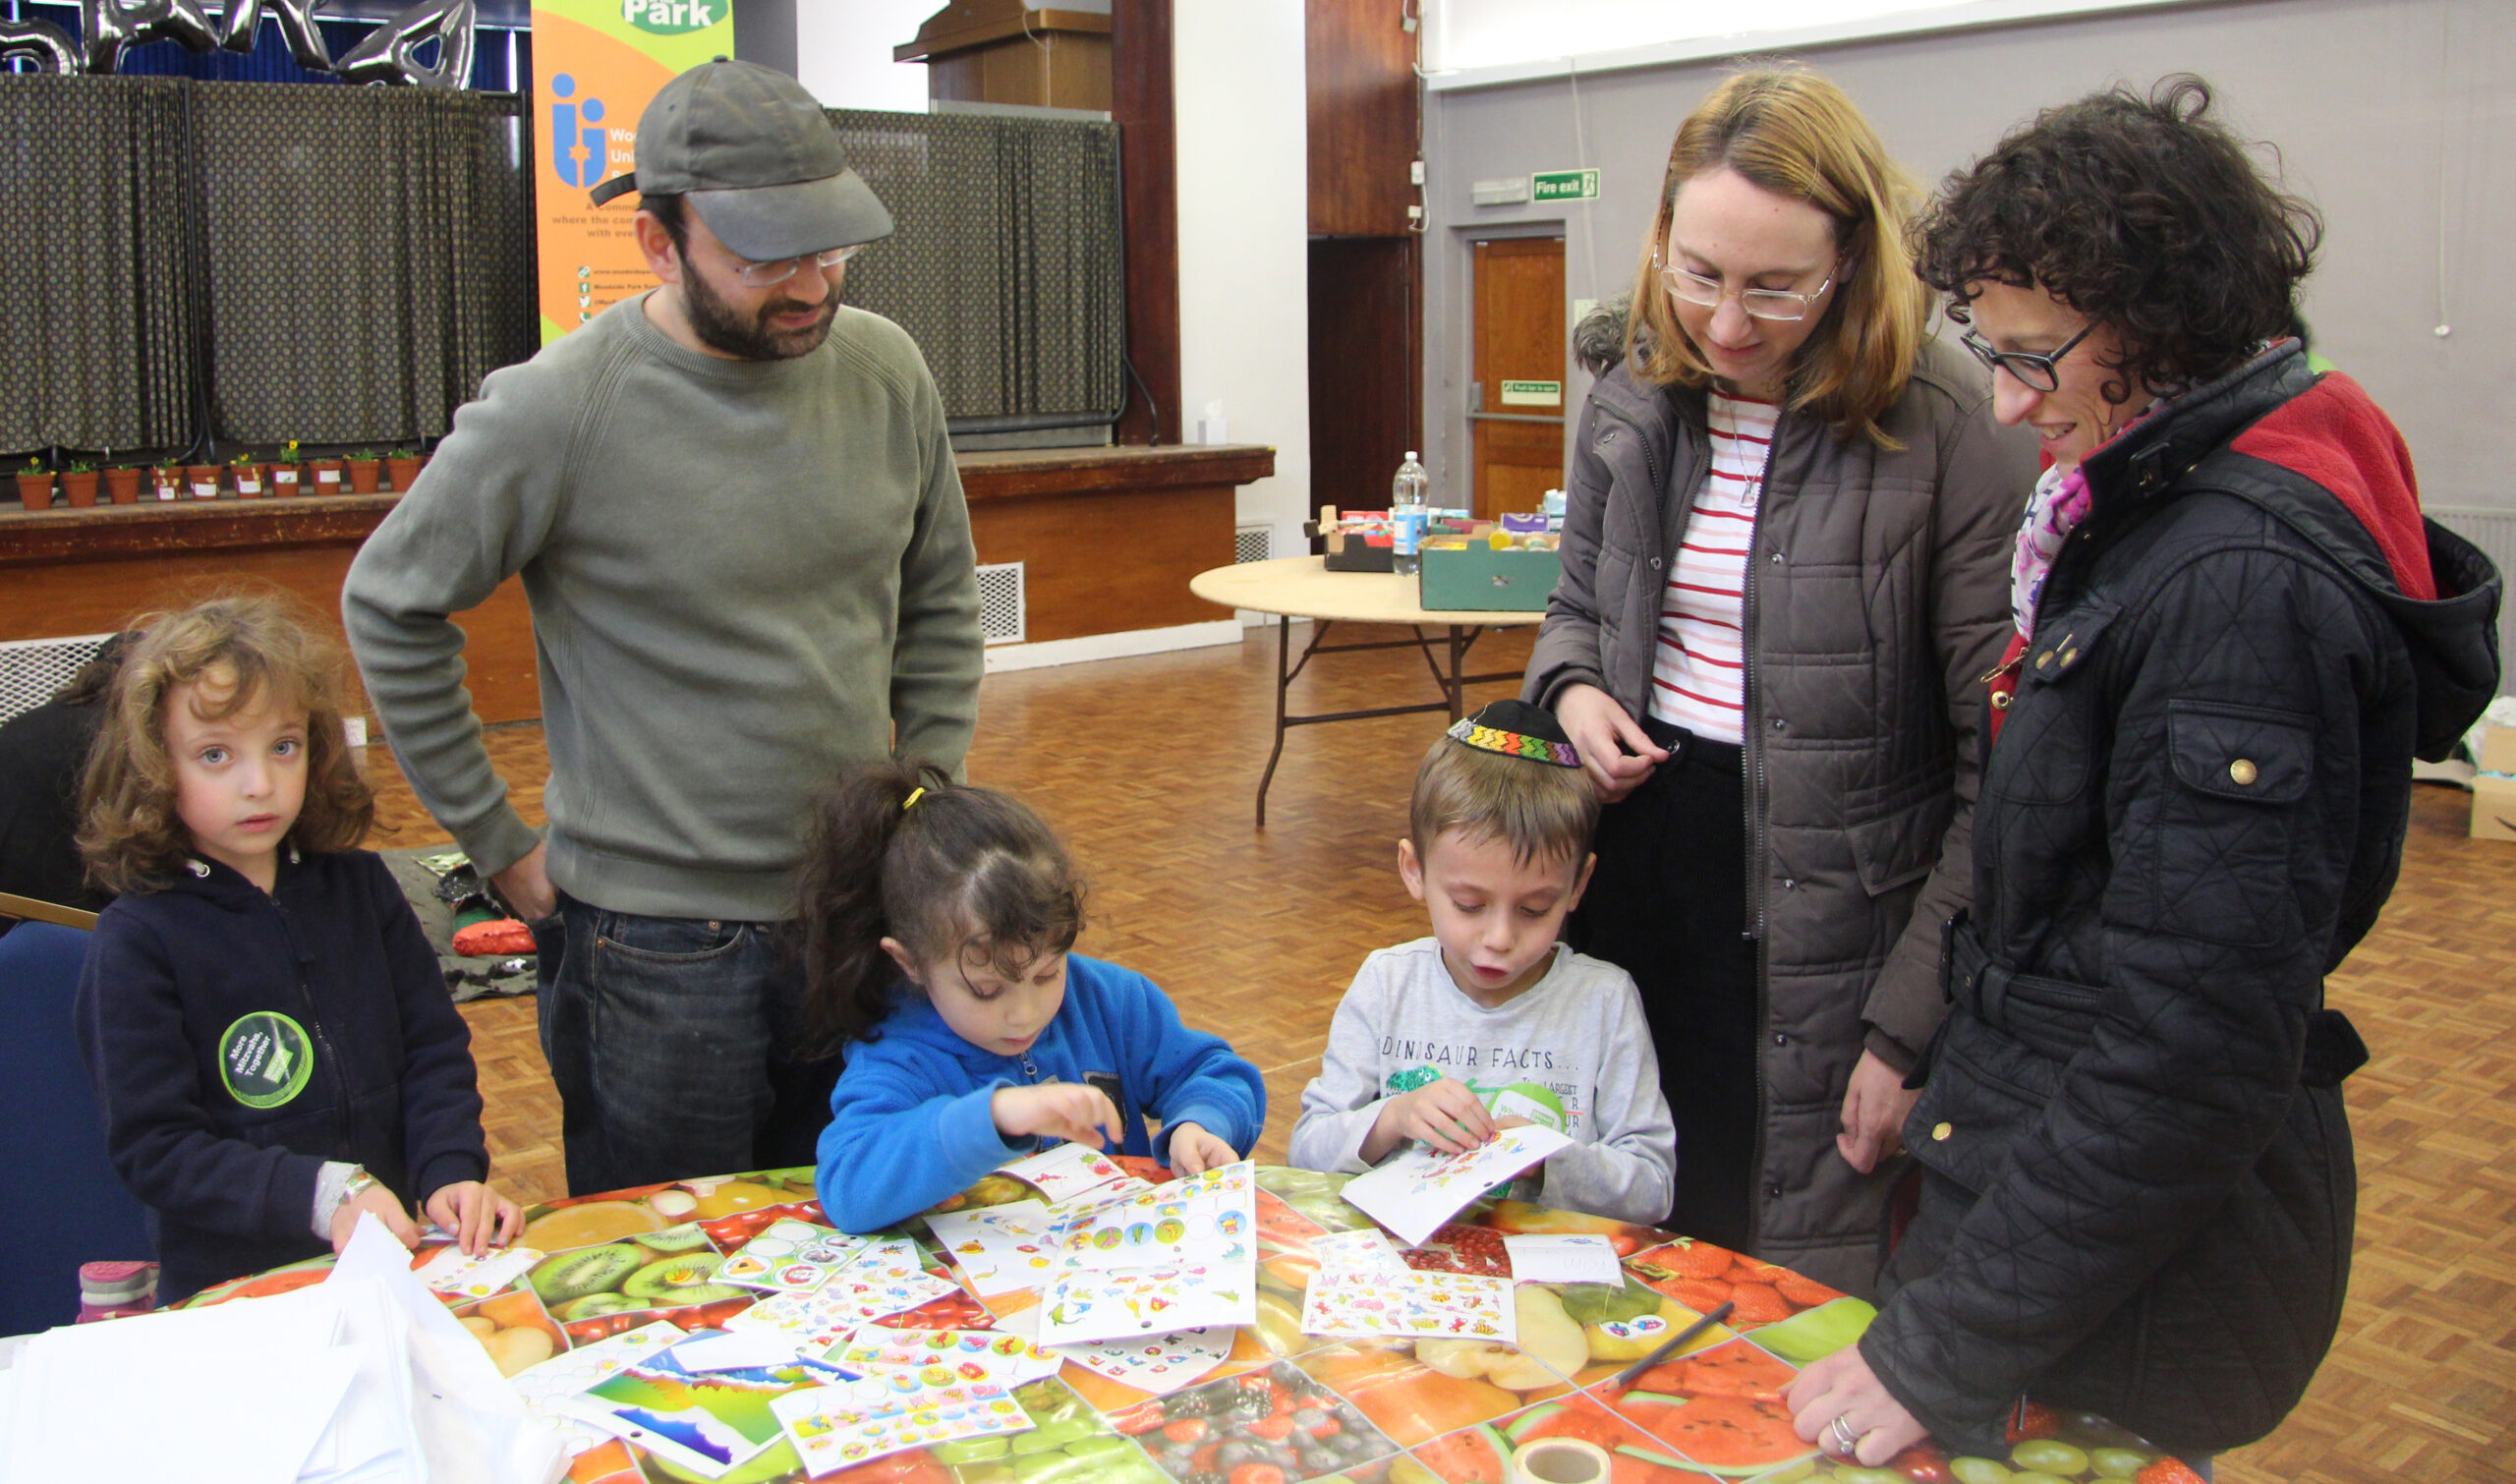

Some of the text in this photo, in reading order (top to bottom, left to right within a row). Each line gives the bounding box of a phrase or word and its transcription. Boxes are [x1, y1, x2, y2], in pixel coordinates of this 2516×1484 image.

[624, 0, 713, 27] Park
[1536, 179, 1580, 194] Fire exit
[551, 215, 588, 224] where
[591, 215, 609, 224] the
[230, 1034, 248, 1060] More
[234, 1031, 264, 1074] Mitzvahs,
[245, 1035, 271, 1077] Together
